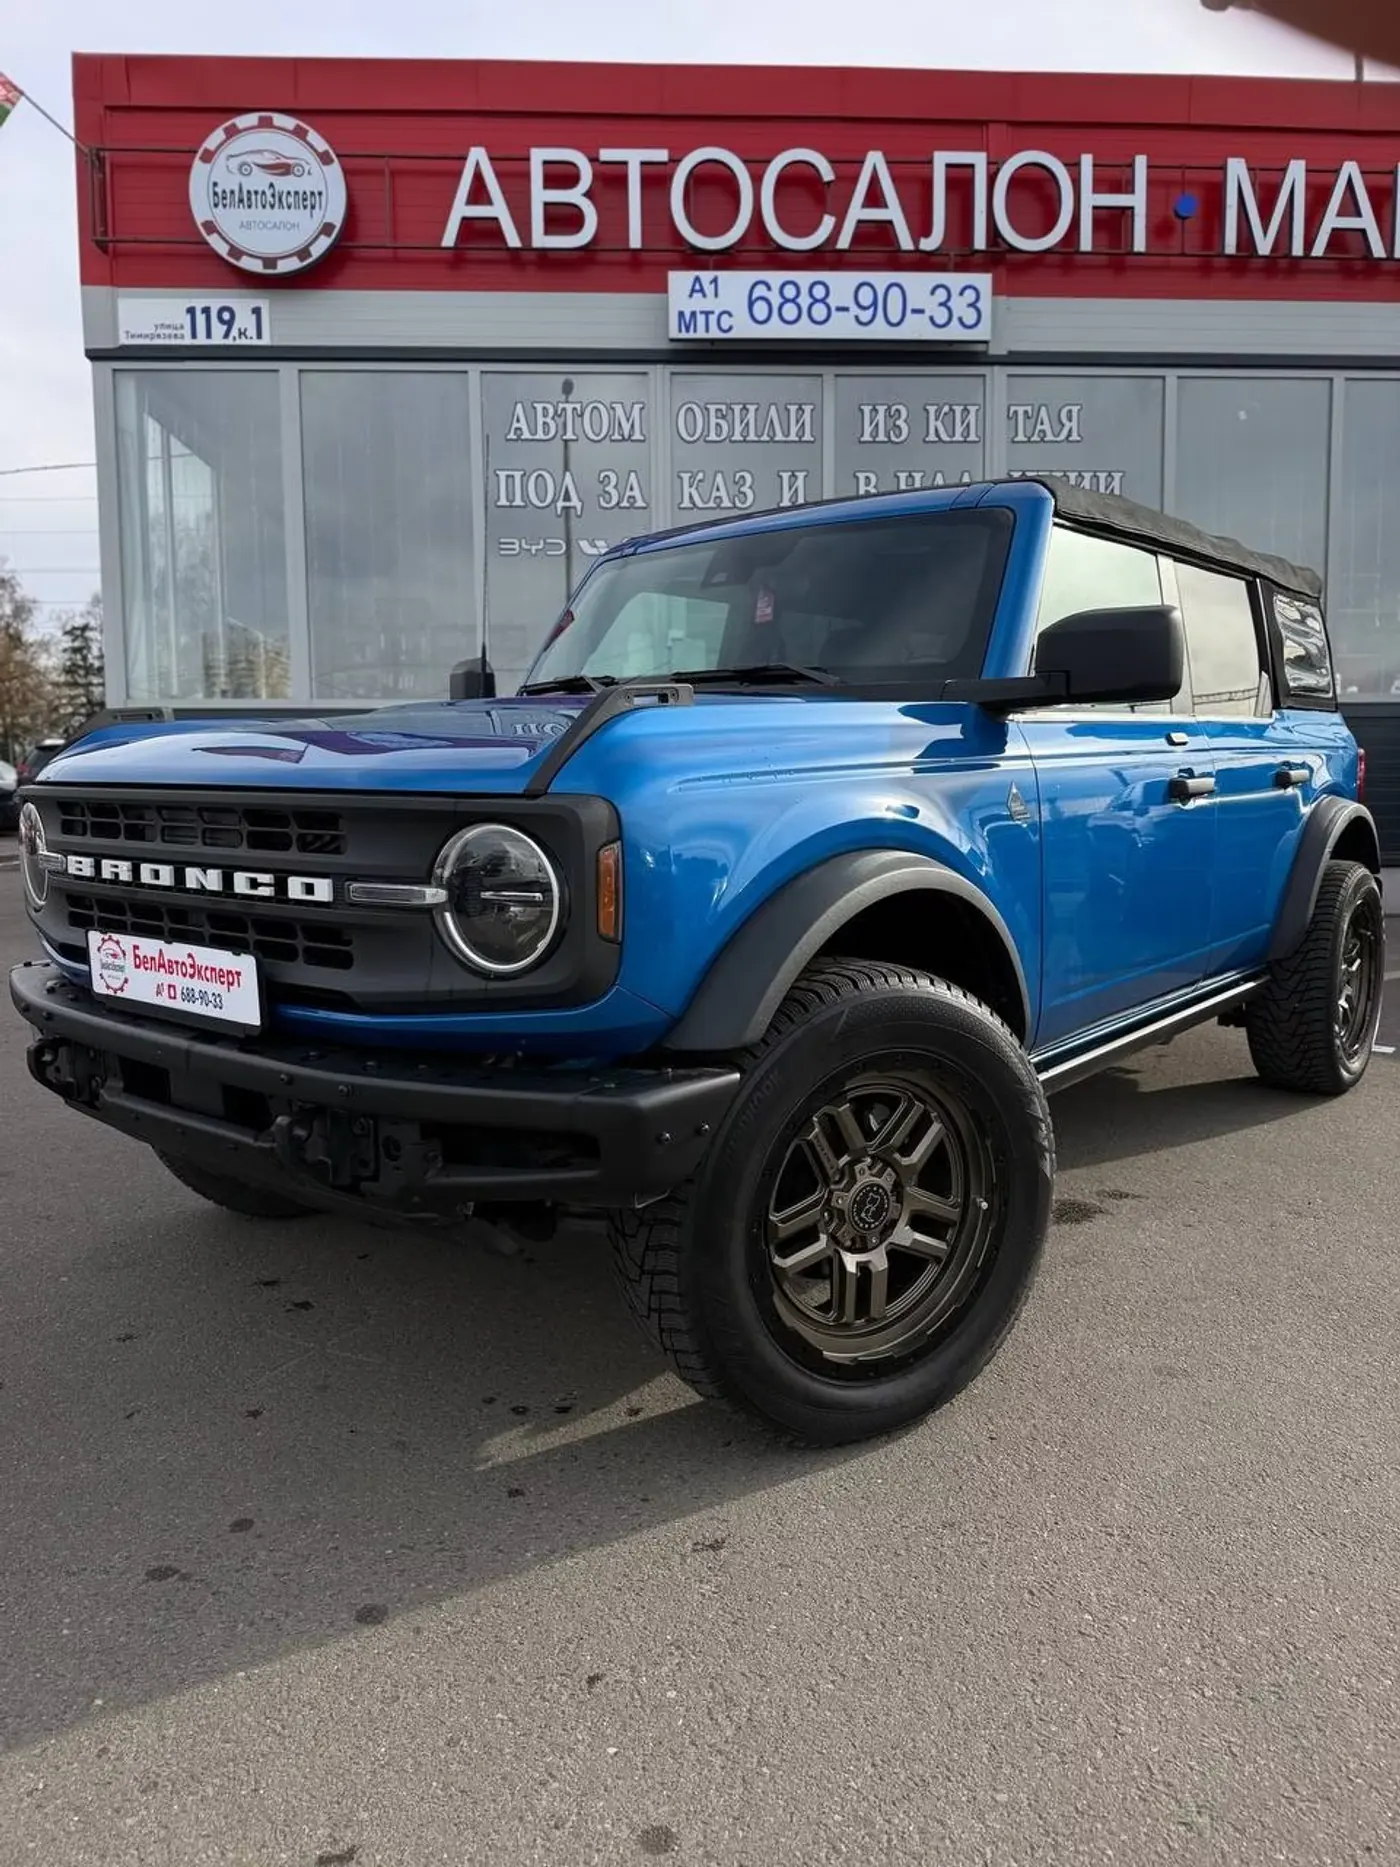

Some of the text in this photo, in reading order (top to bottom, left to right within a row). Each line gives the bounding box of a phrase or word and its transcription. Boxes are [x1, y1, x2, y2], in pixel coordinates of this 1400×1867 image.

[212, 181, 323, 219] БелАвтоЭксперт
[440, 146, 1148, 253] АВТОСАЛОН
[239, 219, 300, 231] АВТОСАЛОН
[677, 310, 734, 334] МТС
[747, 279, 982, 330] 688-90-33
[859, 404, 909, 443] ИЗ
[495, 469, 584, 517] ПОД
[778, 470, 808, 508] И
[66, 854, 334, 903] BRONCO
[132, 944, 242, 993] БелАвтоЭксперт
[180, 985, 224, 1011] 688-90-33
